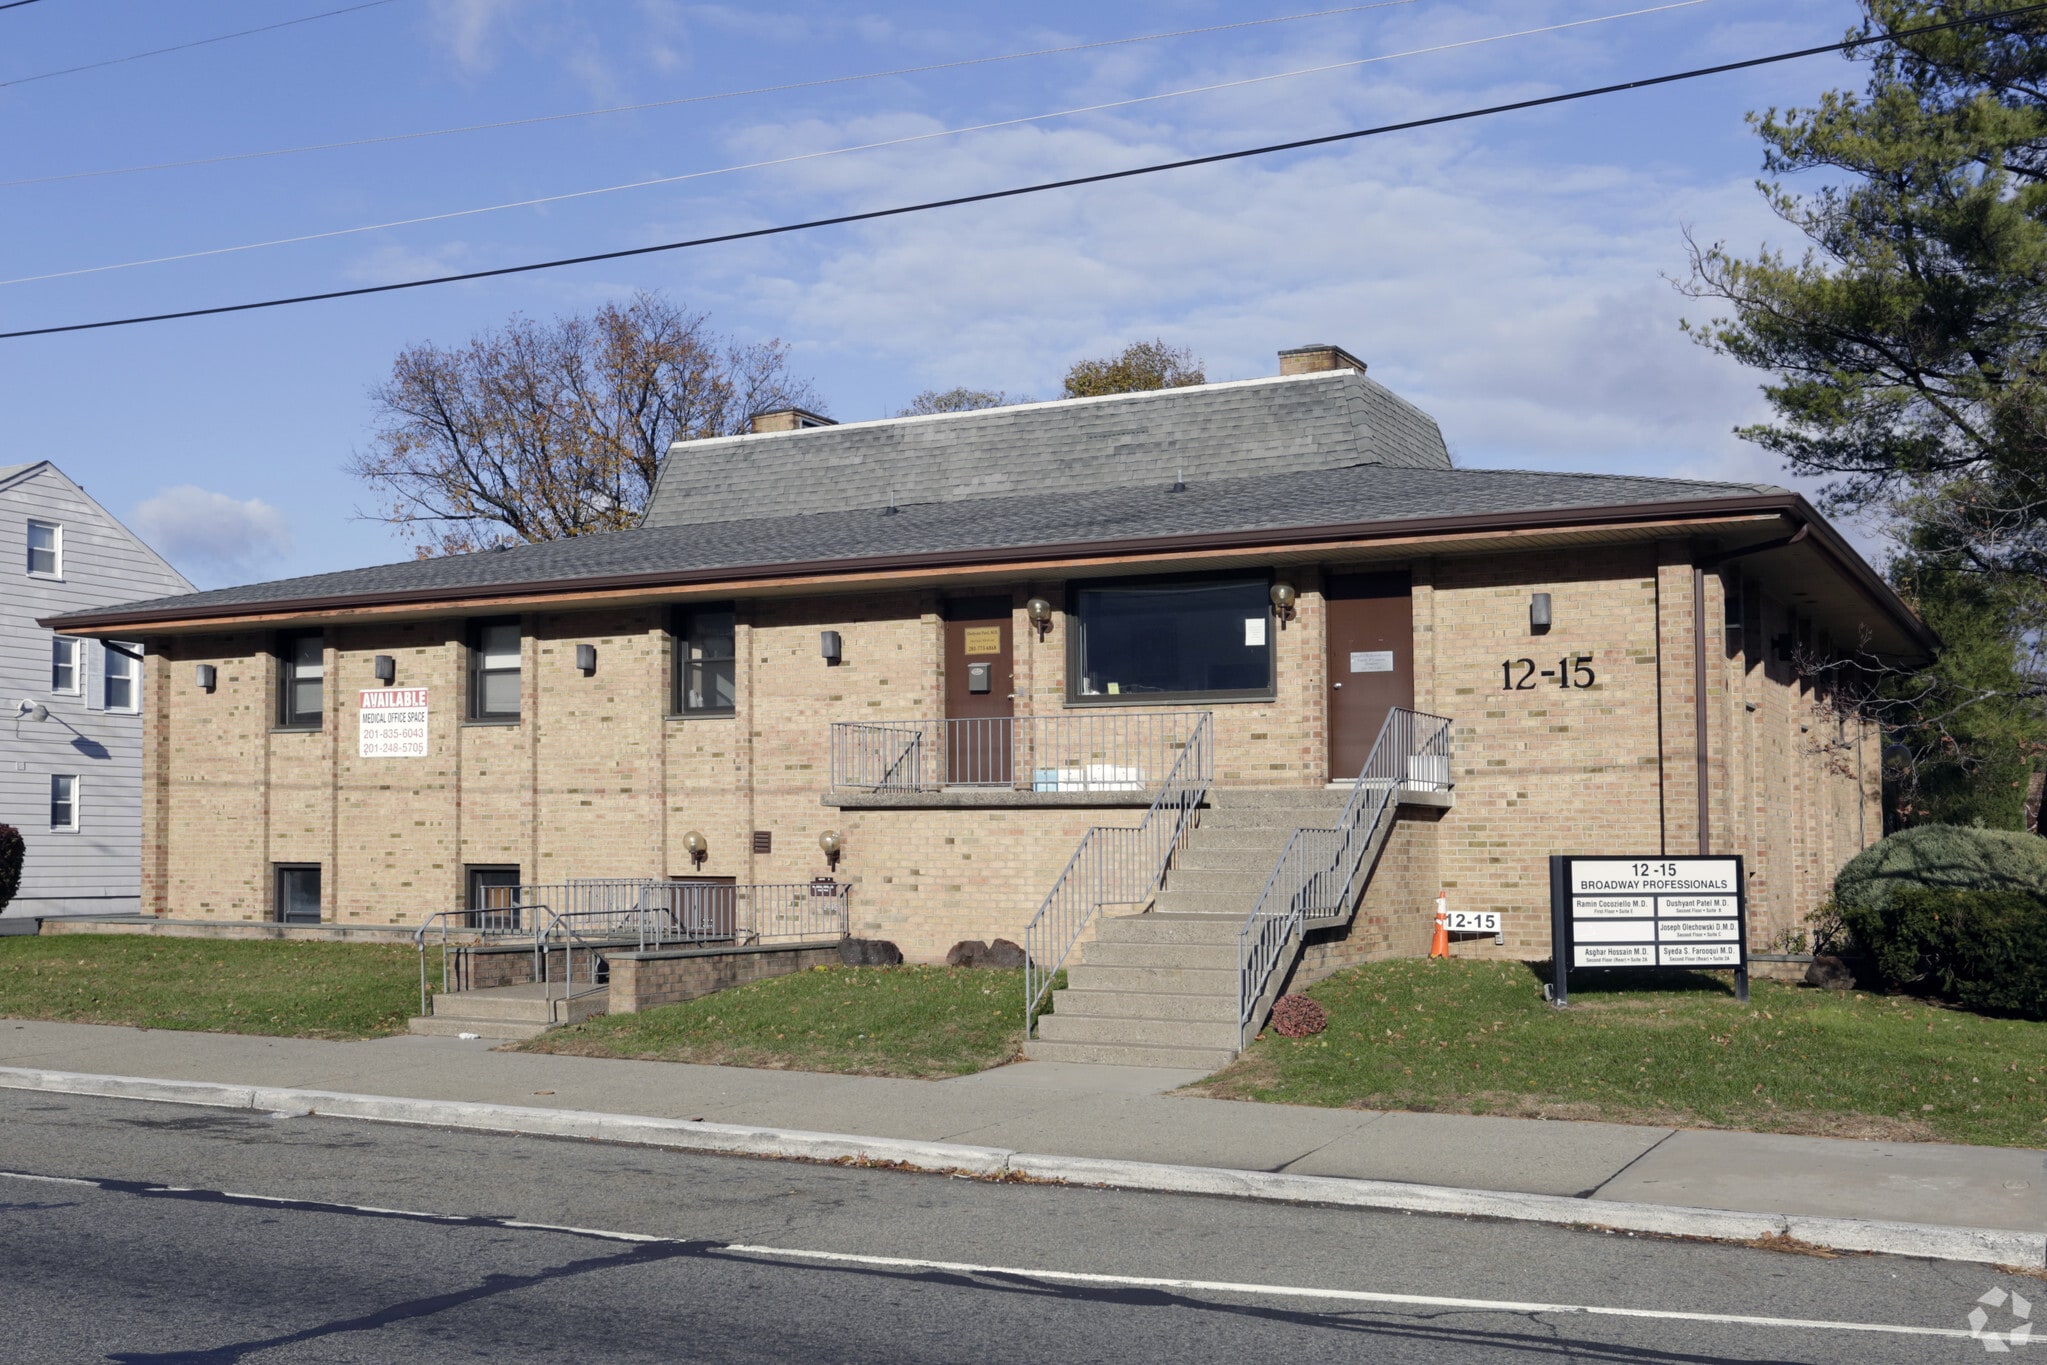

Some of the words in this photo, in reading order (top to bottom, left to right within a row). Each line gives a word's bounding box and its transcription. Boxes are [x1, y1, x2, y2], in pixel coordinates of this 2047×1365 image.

[1502, 656, 1595, 690] 12-15
[362, 691, 426, 708] AVAILABLE
[362, 712, 386, 723] MEDICAL
[387, 712, 406, 723] OFFICE
[407, 711, 425, 722] SPACE
[363, 728, 424, 739] 201-835-6043
[363, 742, 424, 753] 201-248-5705
[1581, 880, 1639, 890] BROADWAY
[1643, 879, 1728, 889] PROFESSIONALS
[1666, 899, 1695, 908] Dushyant
[1696, 899, 1712, 907] Patel
[1713, 899, 1729, 907] M.D.
[1446, 913, 1495, 929] 12-15
[1660, 923, 1681, 931] Joseph
[1682, 923, 1714, 931] Olechowski
[1585, 948, 1606, 957] Asghar
[1663, 947, 1682, 956] Syeda
[1683, 947, 1690, 955] S.
[1692, 947, 1718, 955] Farooqui
